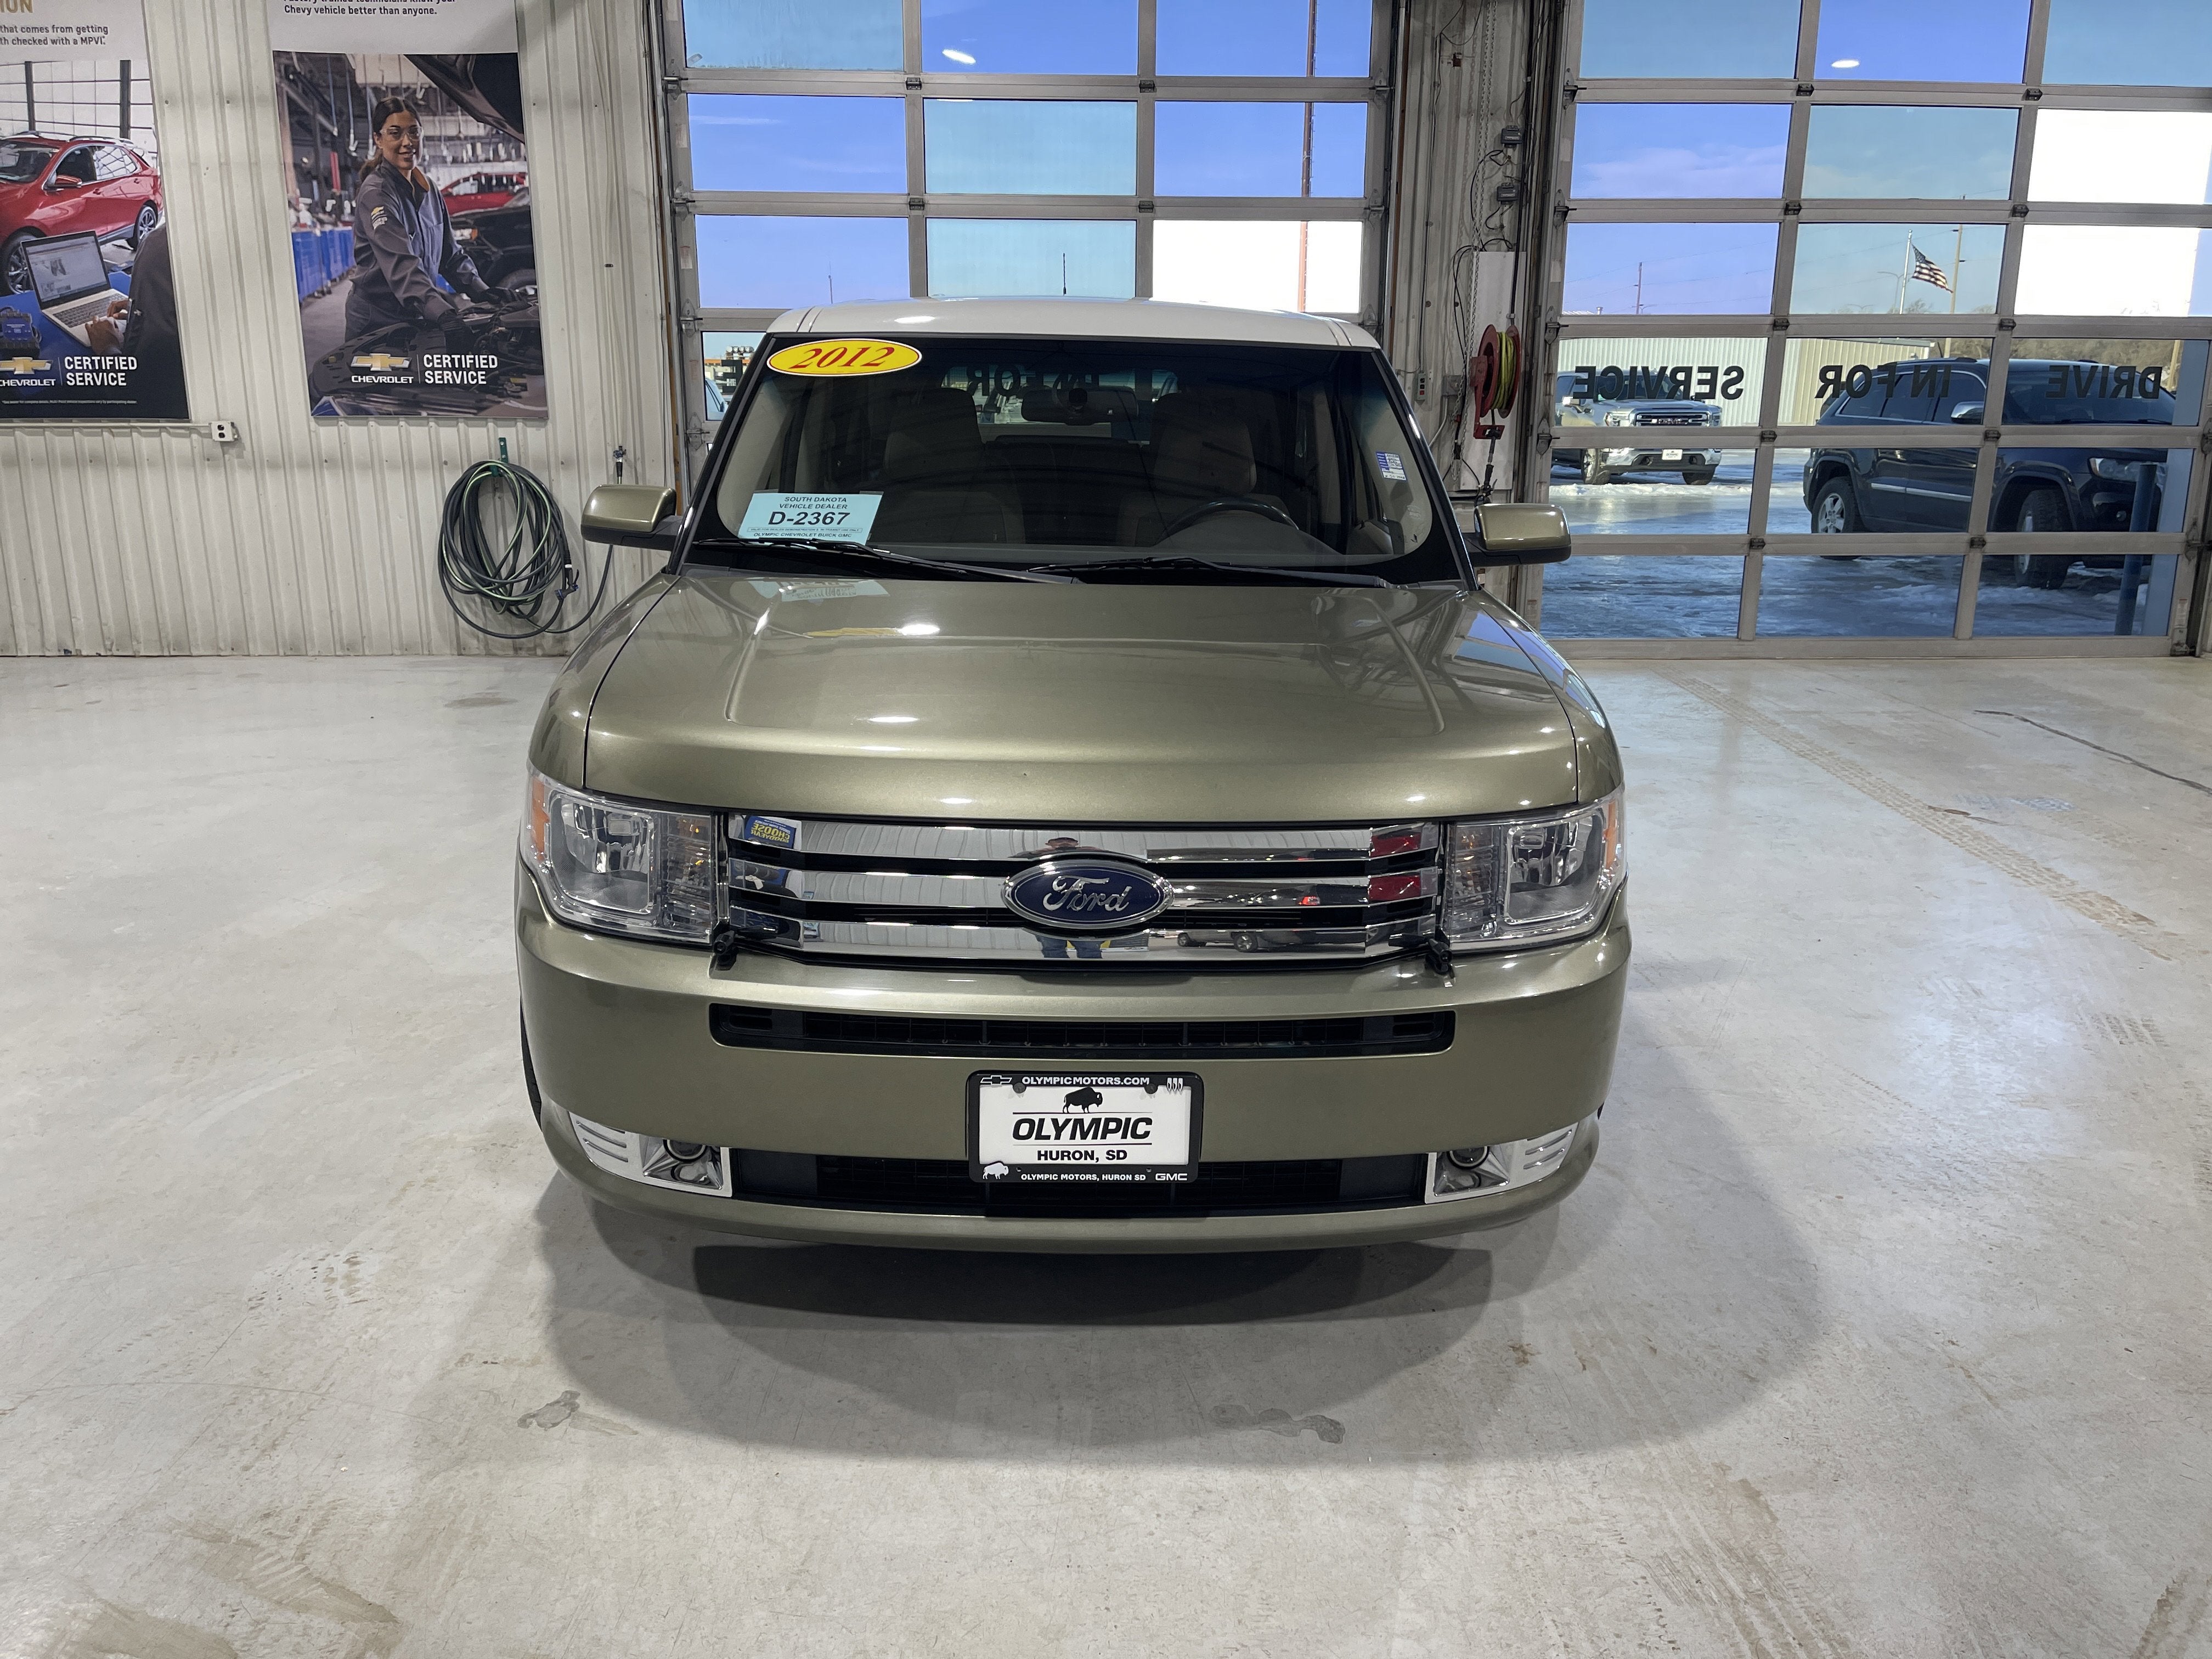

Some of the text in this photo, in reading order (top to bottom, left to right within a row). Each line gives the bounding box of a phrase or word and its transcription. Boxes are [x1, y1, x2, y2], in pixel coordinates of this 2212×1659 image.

[285, 5, 437, 16] Chevy vehicle better than anyone.
[52, 25, 73, 33] from
[76, 25, 108, 35] getting
[12, 37, 48, 45] checked
[51, 37, 70, 45] with
[65, 357, 137, 370] CERTIFIED
[424, 354, 498, 369] CERTIFIED
[788, 347, 895, 369] 2012
[66, 373, 126, 386] SERVICE
[351, 375, 414, 383] CHEVROLET
[425, 371, 487, 384] SERVICE
[768, 511, 850, 525] D-2367
[1043, 876, 1132, 911] Ford
[1022, 1077, 1149, 1085] OLYMPICMOTORS.COM
[1012, 1117, 1153, 1141] OLYMPIC
[1037, 1150, 1127, 1163] HURON, SD
